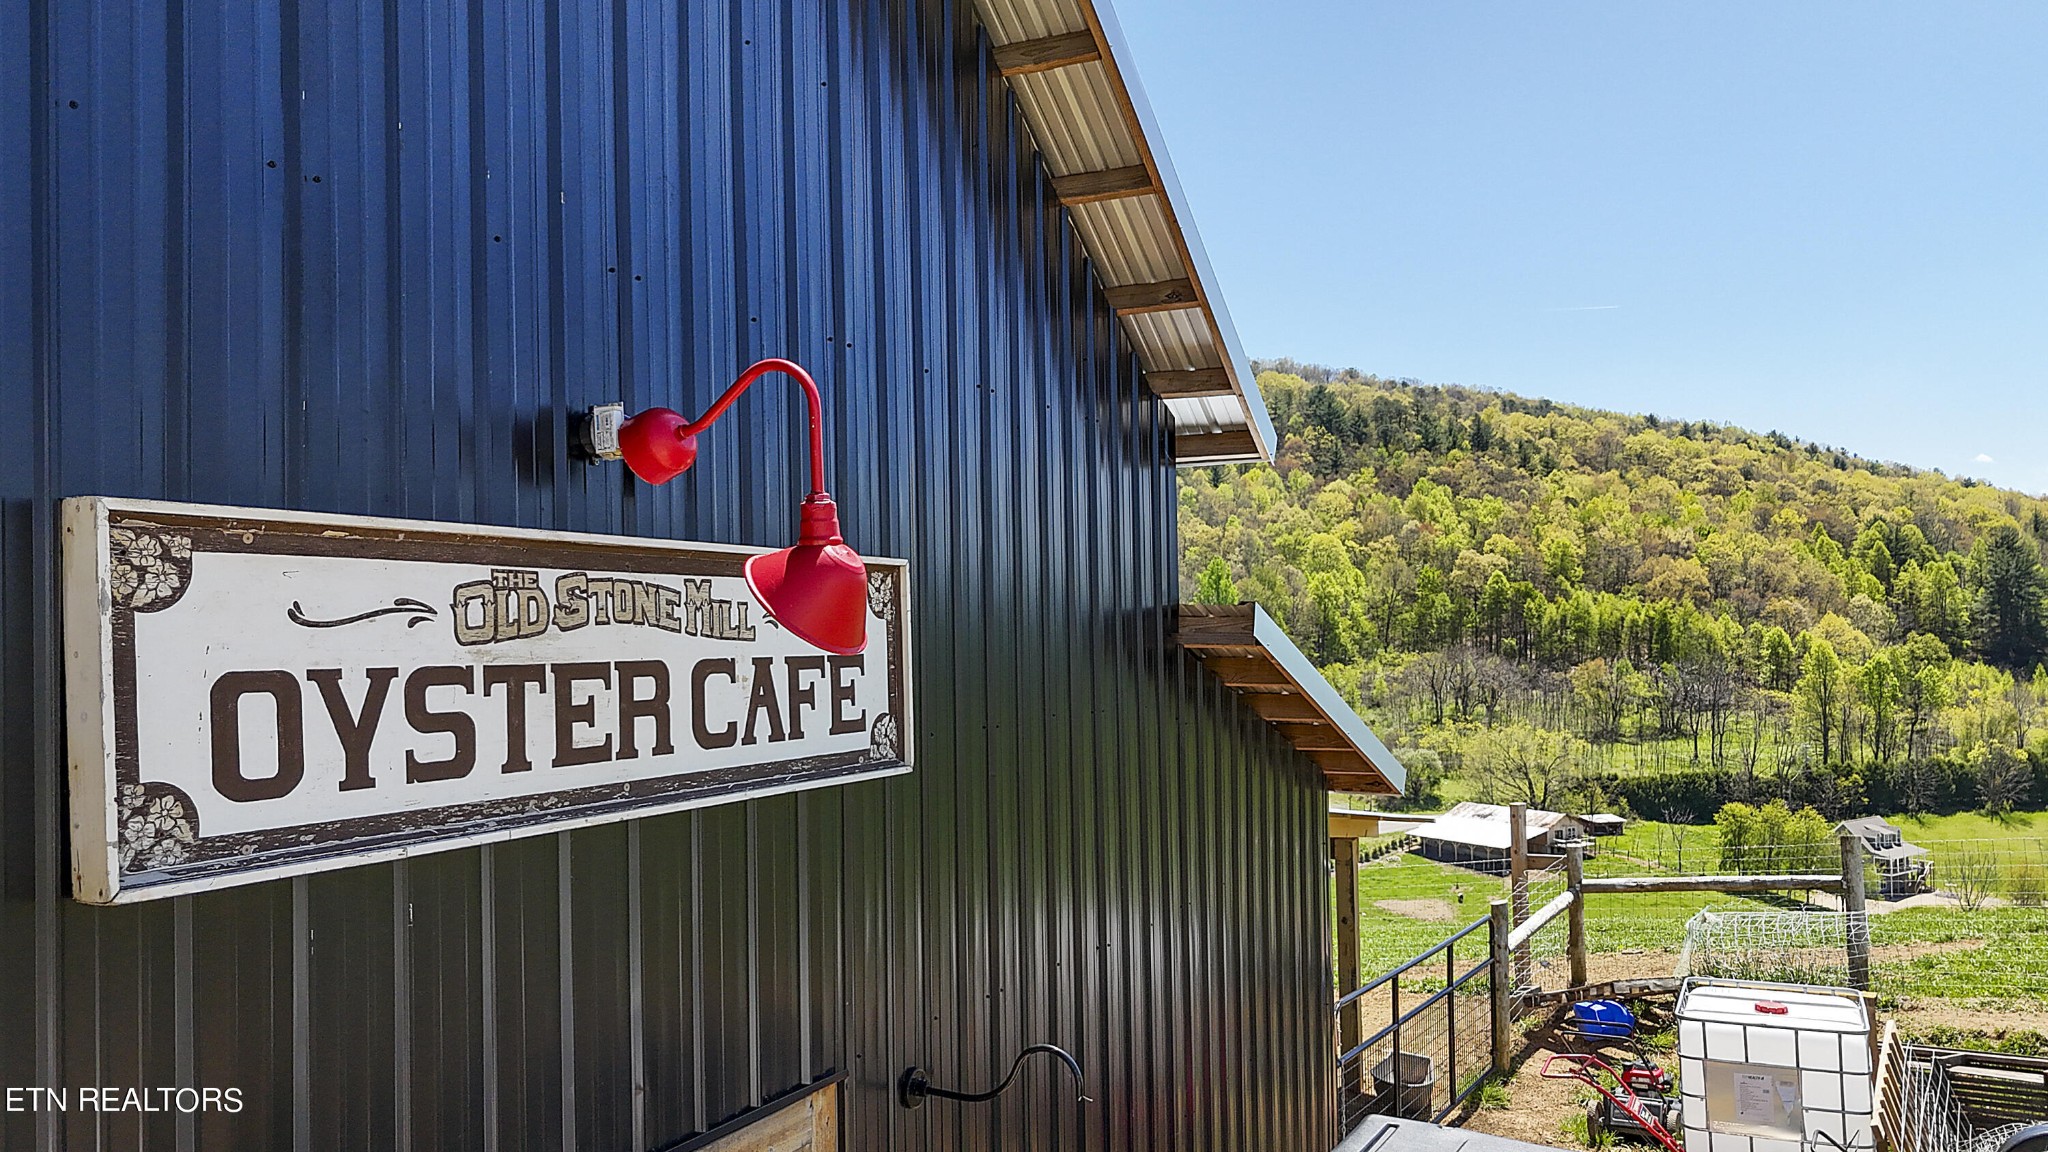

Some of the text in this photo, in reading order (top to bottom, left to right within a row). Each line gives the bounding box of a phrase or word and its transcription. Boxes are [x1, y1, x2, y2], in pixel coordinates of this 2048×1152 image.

[450, 571, 757, 647] OLD STONE MILL
[491, 568, 540, 590] THE
[209, 655, 867, 803] OYSTER CAFE
